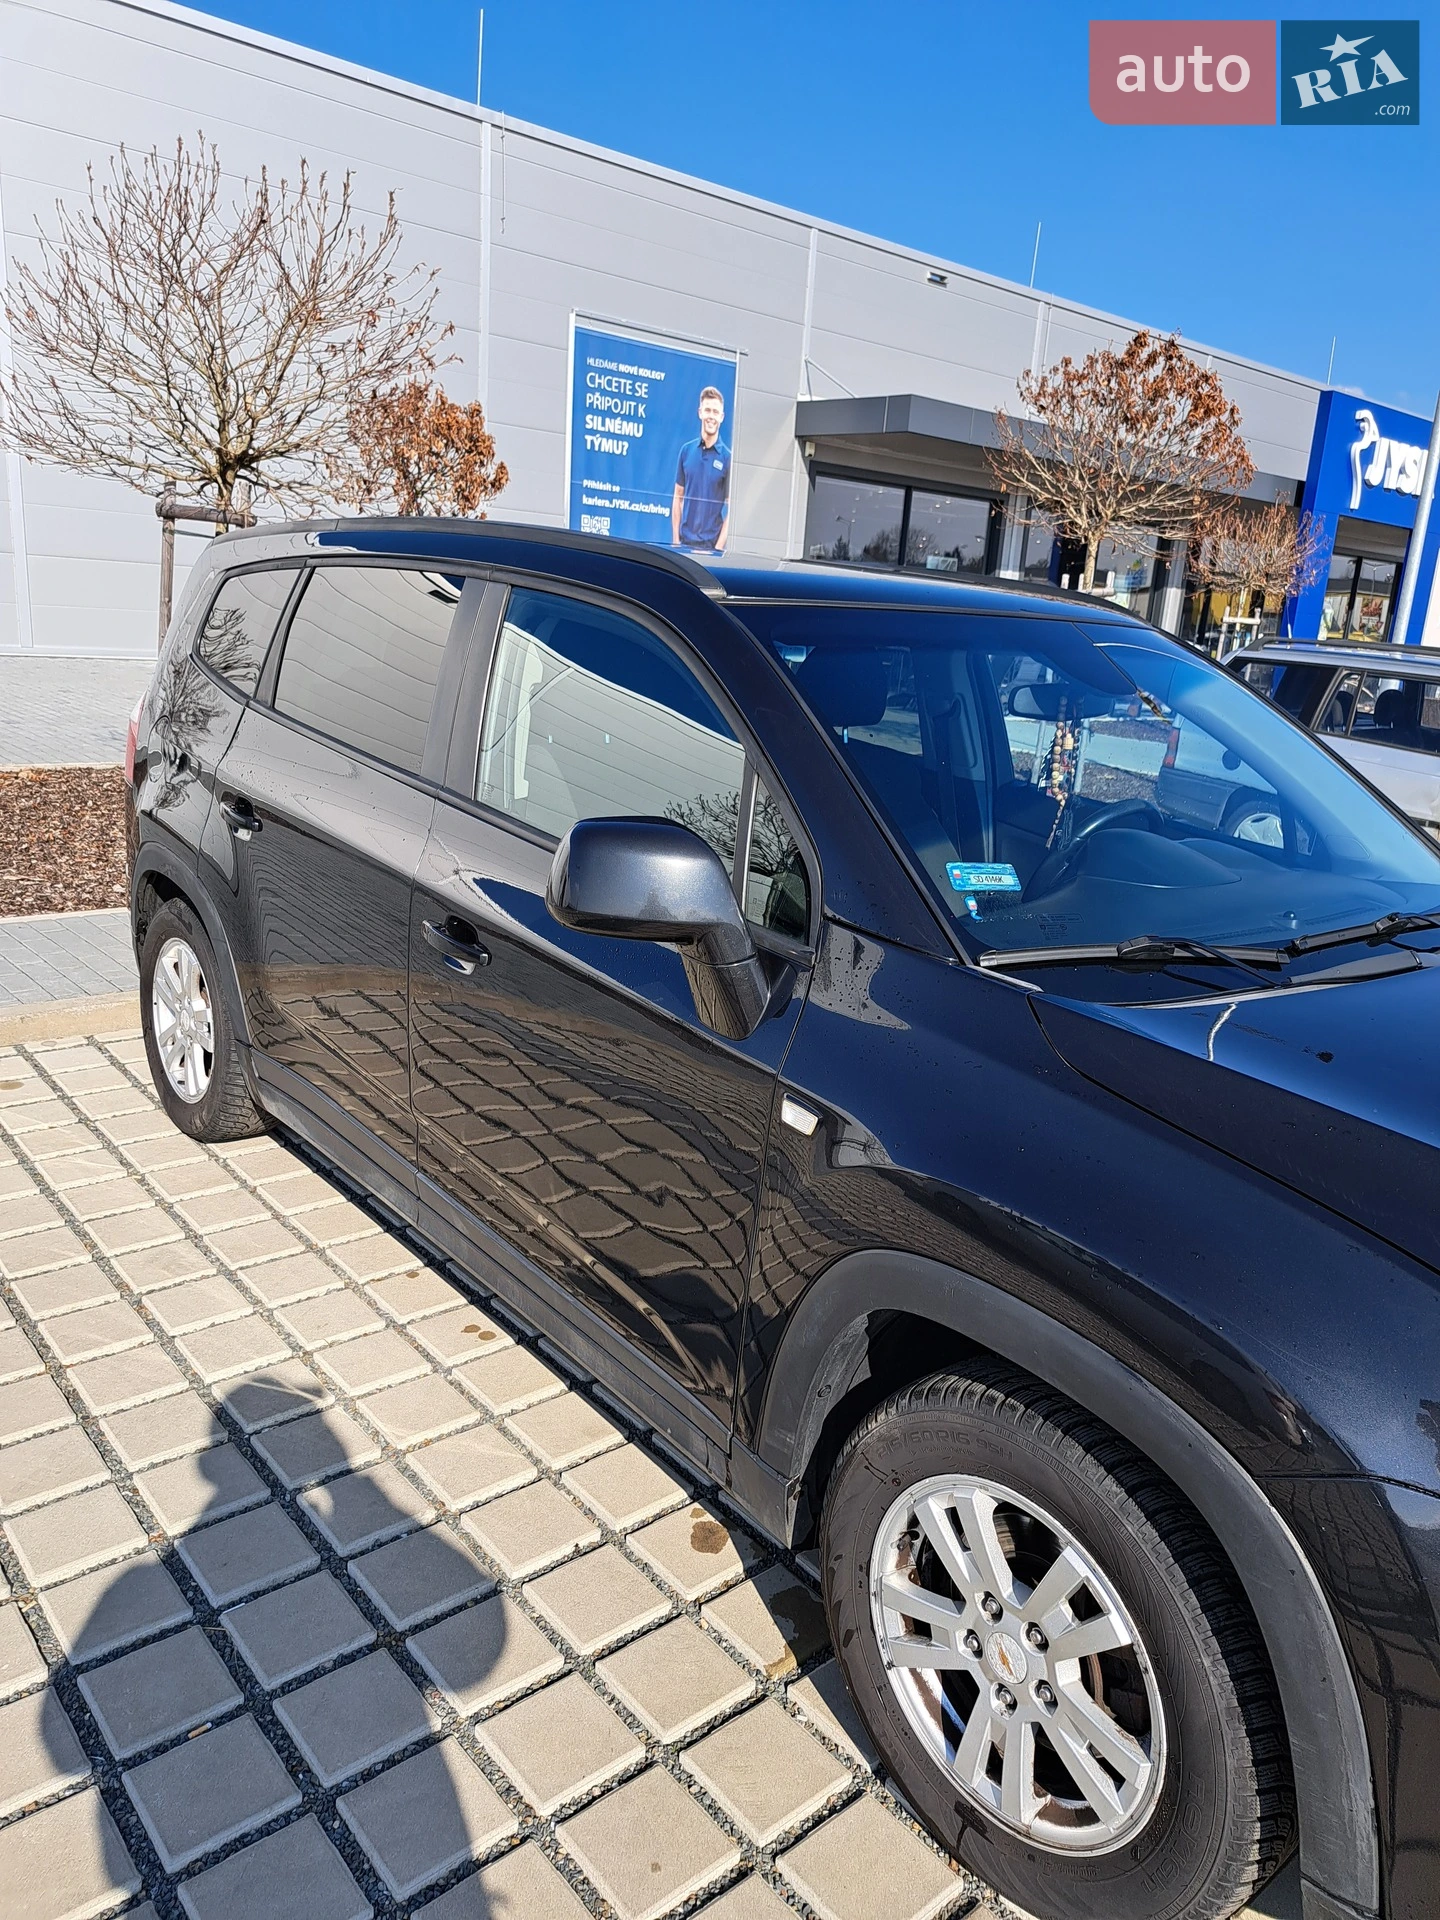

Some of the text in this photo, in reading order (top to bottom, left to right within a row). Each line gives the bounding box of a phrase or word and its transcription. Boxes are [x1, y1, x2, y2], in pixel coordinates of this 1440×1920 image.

[586, 357, 666, 381] HLEDÁME NOVÉ KOLEGY
[586, 372, 649, 398] CHCETE SE
[586, 391, 647, 418] PŘIPOJIT K
[585, 414, 644, 438] SILNÉMU
[584, 433, 629, 456] TÝMU?
[612, 485, 620, 493] se
[582, 494, 670, 517] kariera.JYSK.cz/cz/bring
